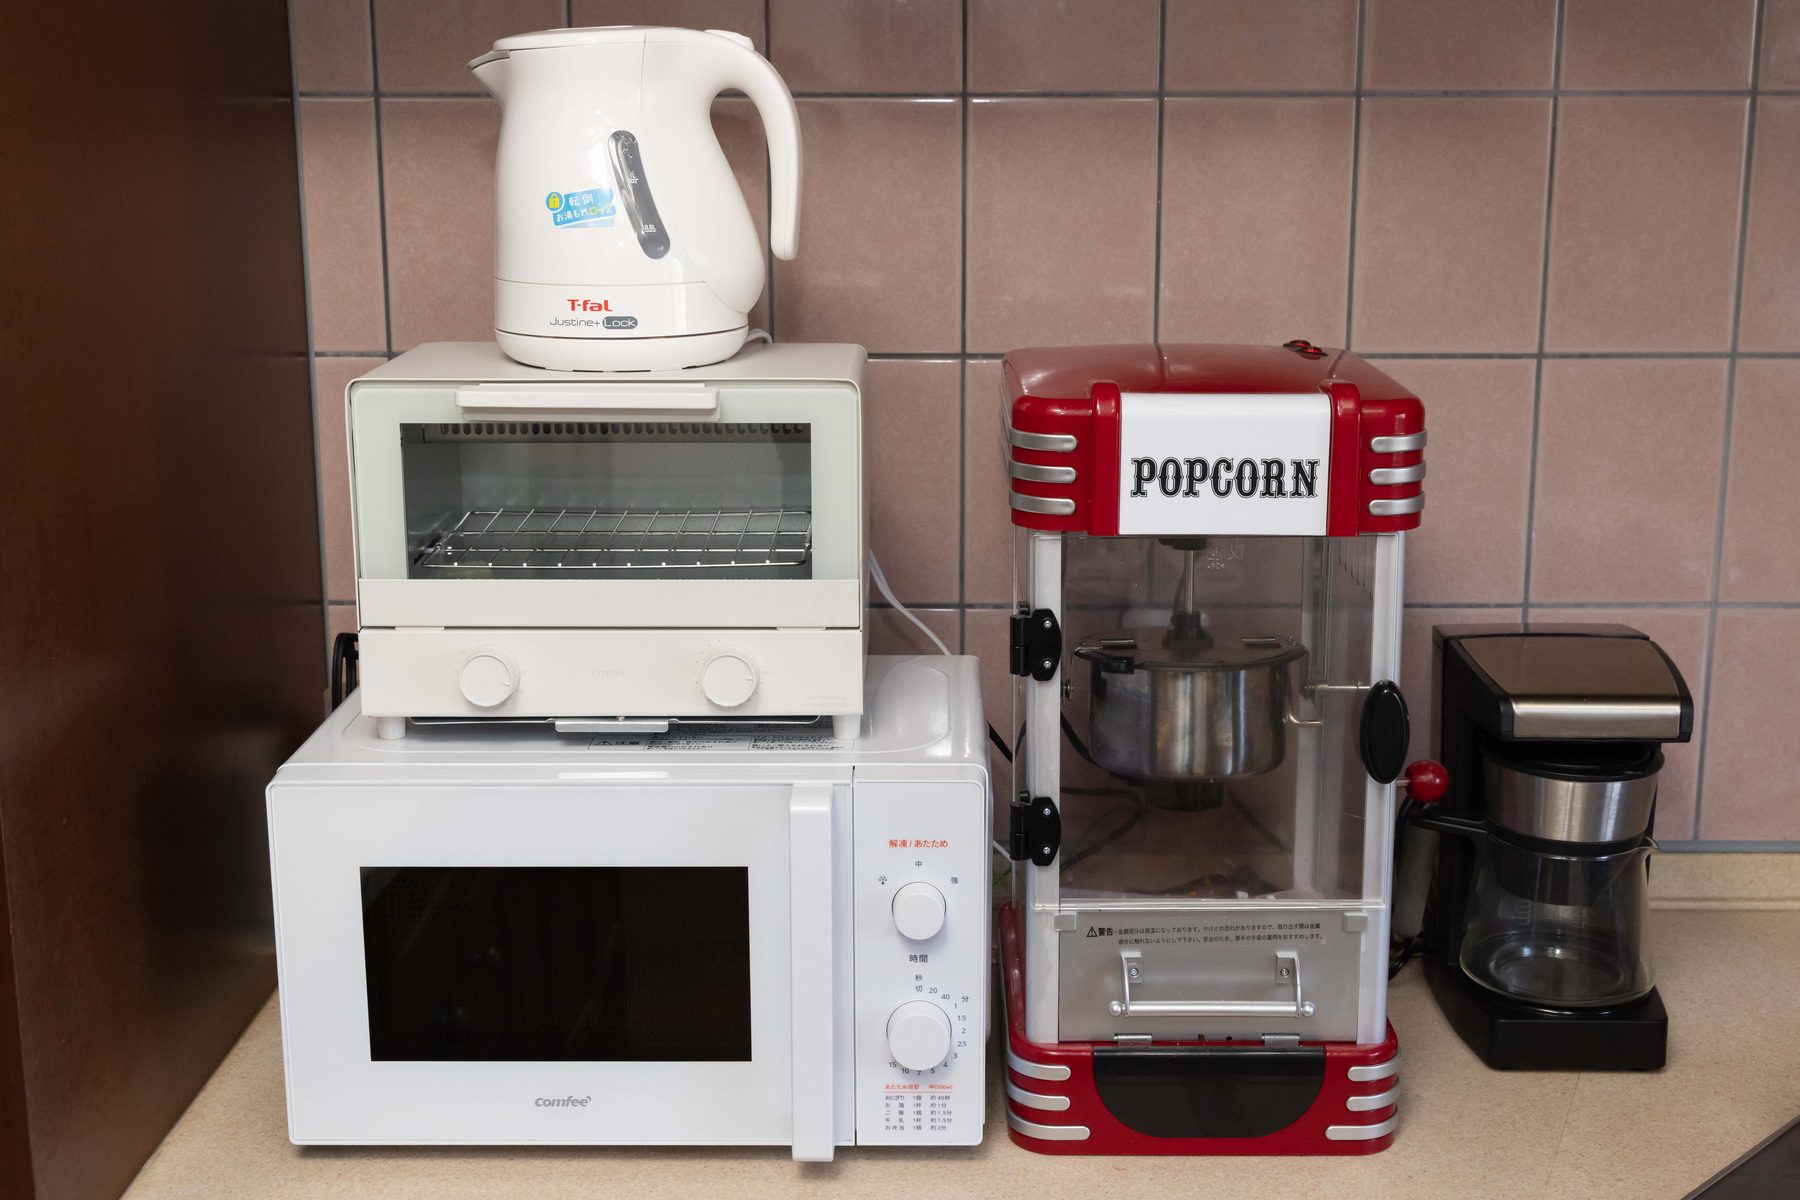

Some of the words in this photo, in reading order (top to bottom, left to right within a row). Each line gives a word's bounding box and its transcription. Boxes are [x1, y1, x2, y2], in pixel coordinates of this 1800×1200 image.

[569, 193, 594, 207] 転倒
[567, 298, 613, 312] T-fal
[603, 318, 636, 327] Lock
[1130, 457, 1320, 499] POPCORN
[915, 860, 923, 868] 中
[909, 954, 928, 963] 時間
[915, 985, 923, 993] 切
